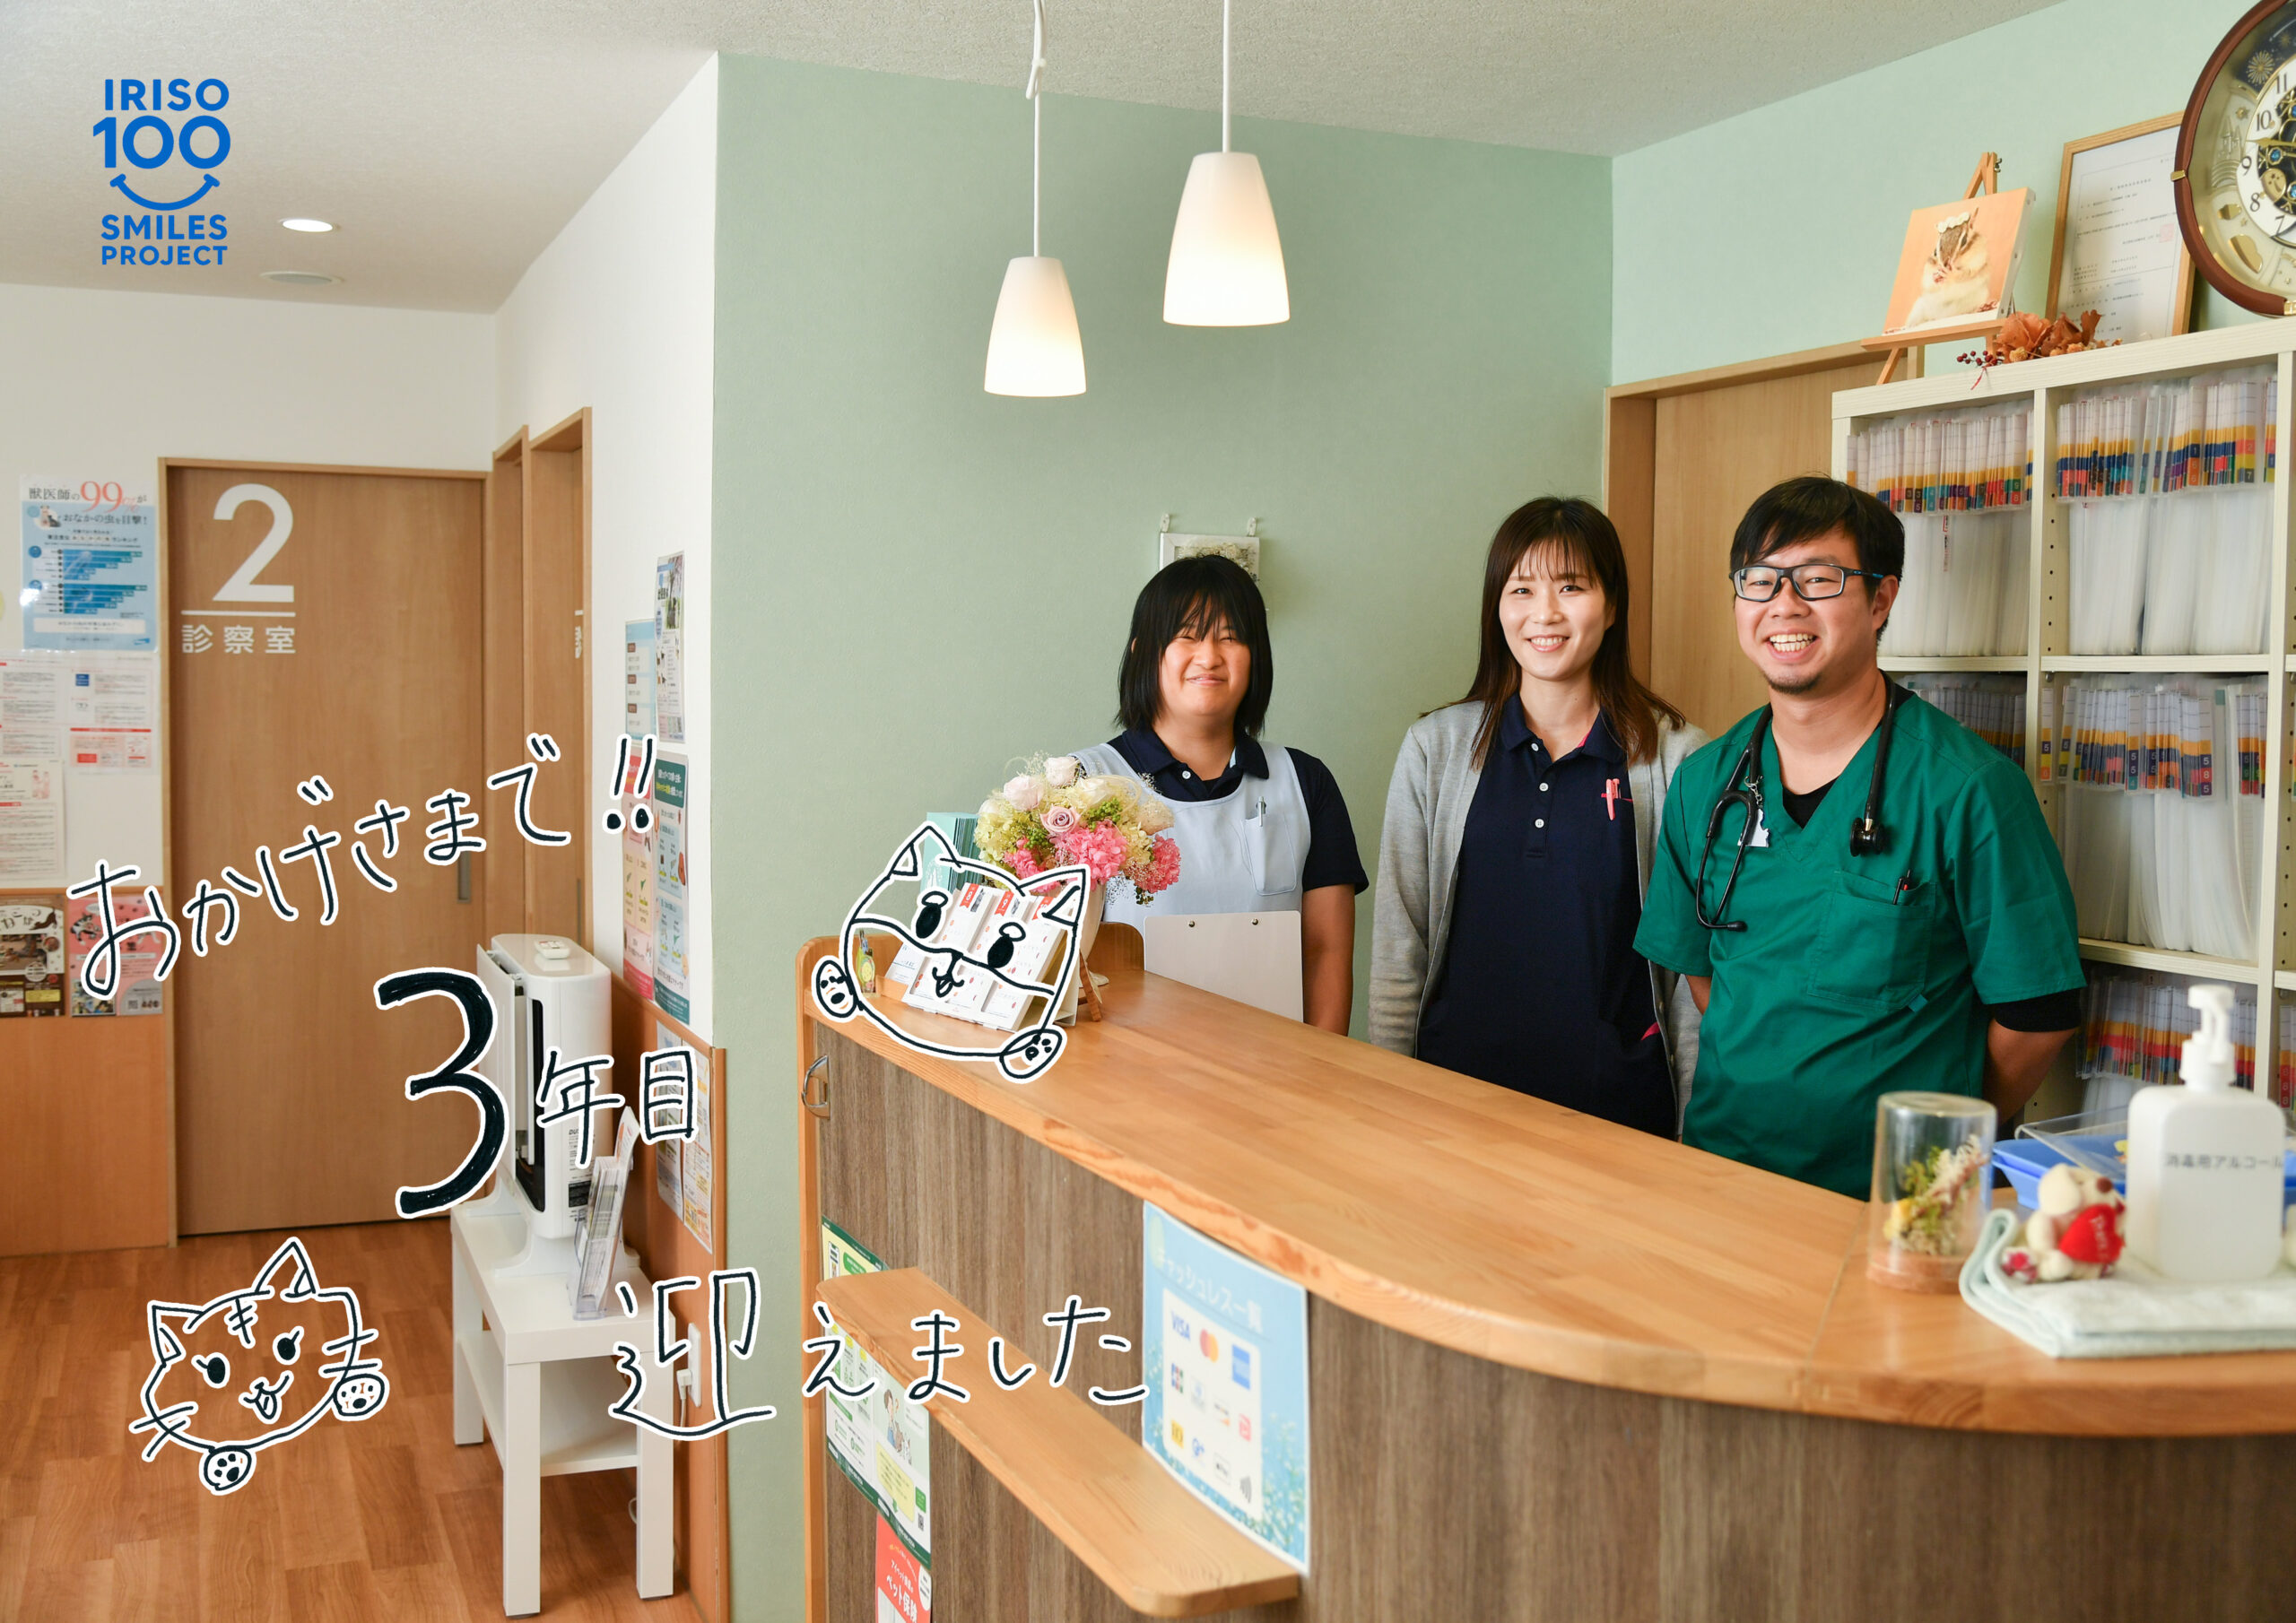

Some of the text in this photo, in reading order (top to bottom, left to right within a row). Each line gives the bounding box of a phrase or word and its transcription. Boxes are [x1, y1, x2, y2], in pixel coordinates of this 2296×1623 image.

[2277, 74, 2287, 94] 11
[2257, 109, 2272, 131] 10
[2241, 155, 2252, 176] 9
[2249, 192, 2260, 213] 8
[2274, 215, 2285, 237] 7
[212, 483, 295, 603] 2
[181, 625, 296, 654] 診察室
[1170, 1310, 1191, 1341] VISA
